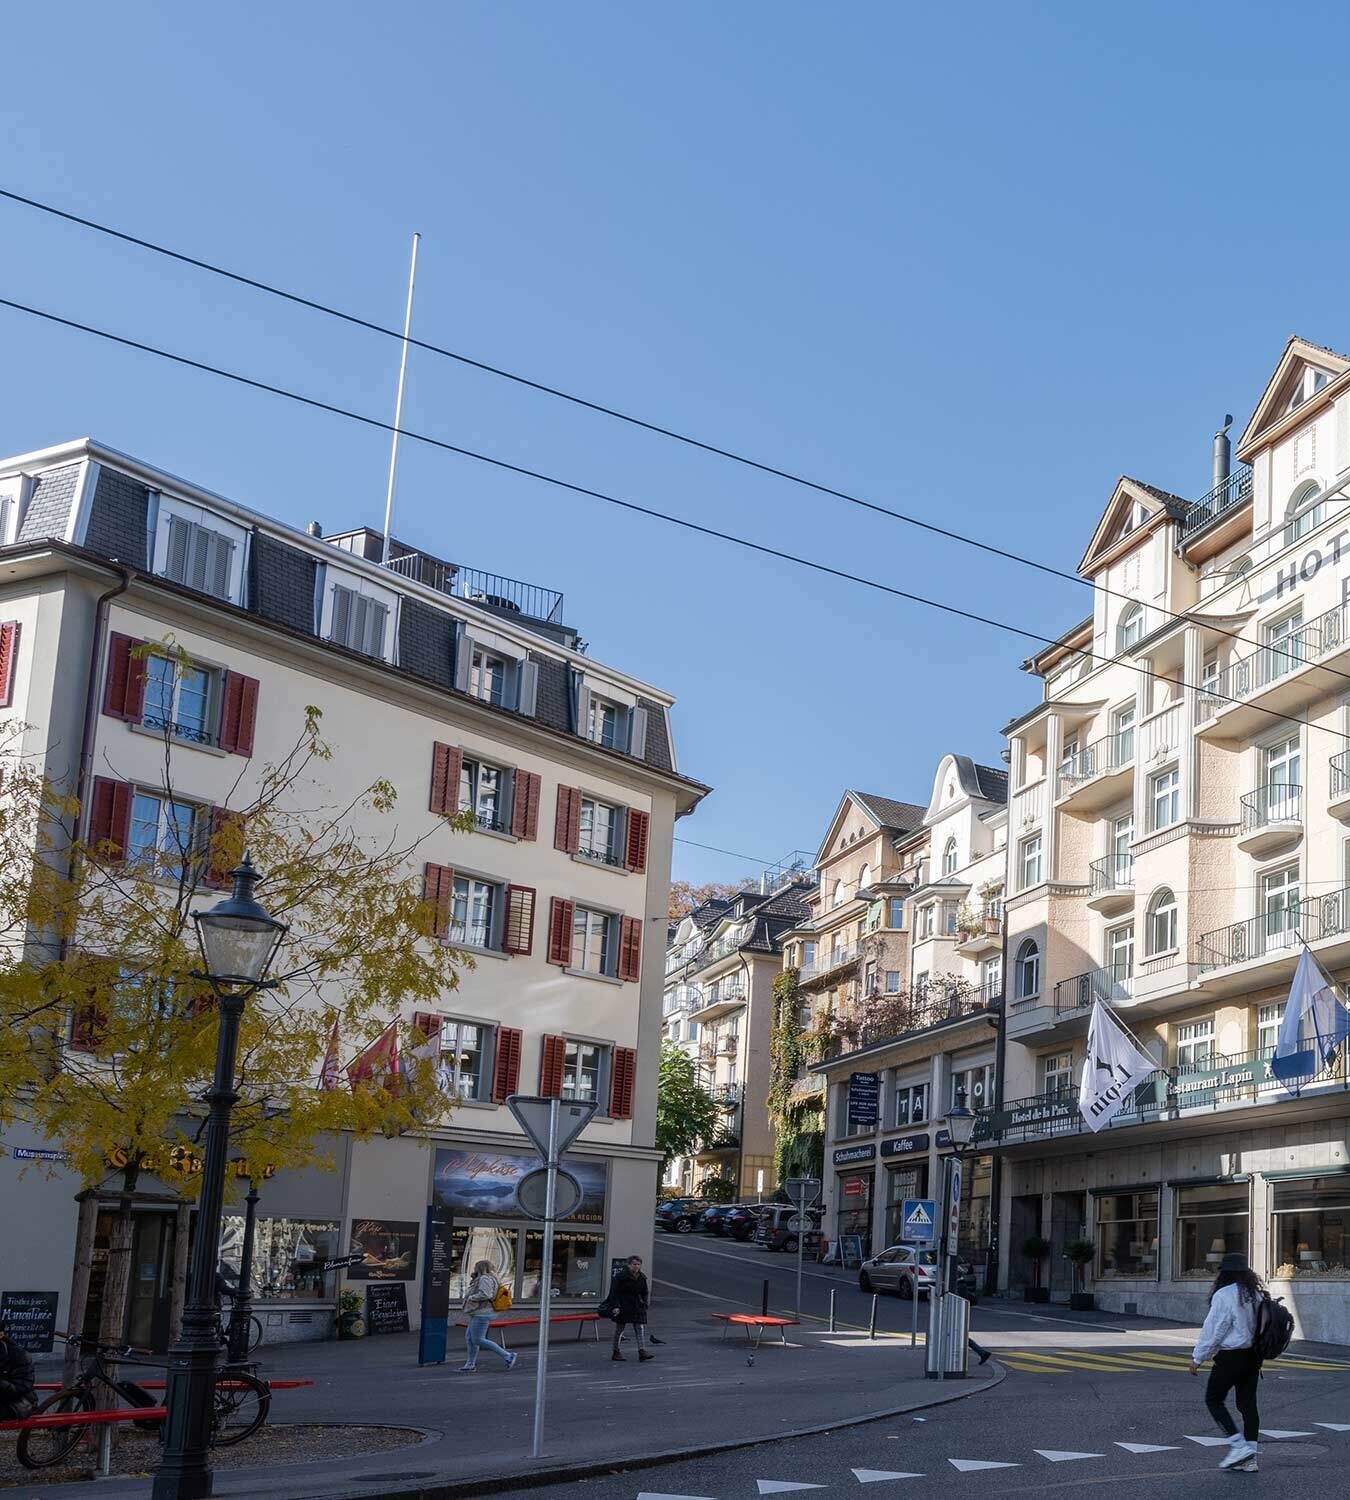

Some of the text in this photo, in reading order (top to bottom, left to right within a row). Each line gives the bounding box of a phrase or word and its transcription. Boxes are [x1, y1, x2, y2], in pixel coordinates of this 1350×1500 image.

[1221, 1068, 1253, 1087] Lapin
[1012, 1103, 1070, 1123] Hotel de la Paix
[893, 1140, 914, 1152] Kaffee
[835, 1148, 872, 1162] Schuhmacherei
